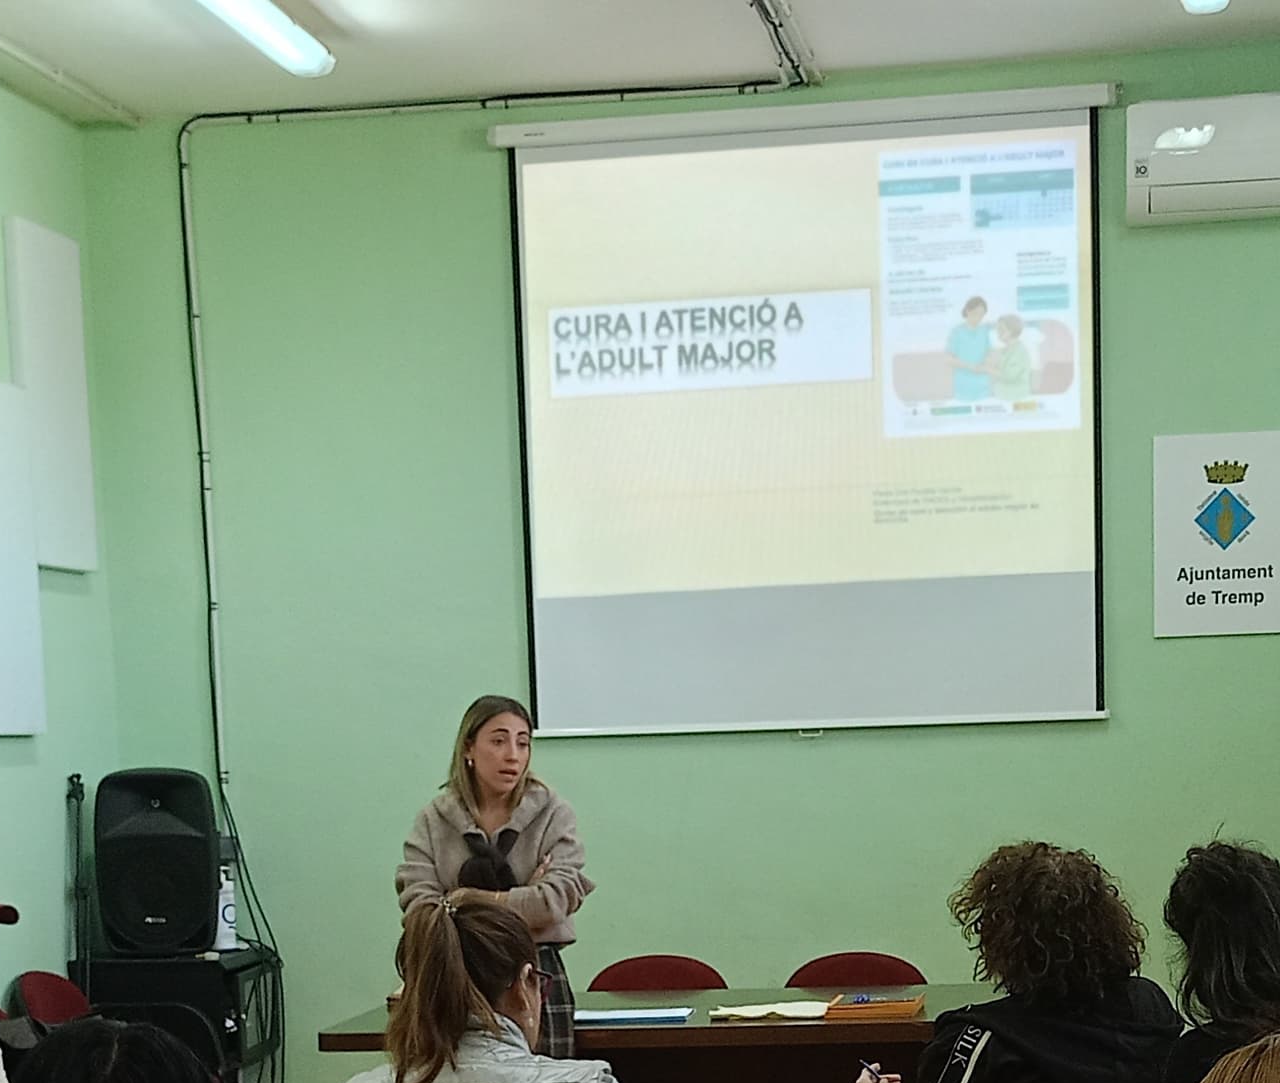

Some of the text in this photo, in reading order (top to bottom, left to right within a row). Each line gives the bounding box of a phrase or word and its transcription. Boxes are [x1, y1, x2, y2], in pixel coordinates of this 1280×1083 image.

[554, 298, 804, 340] CURA I ATENCIÓ A
[555, 338, 776, 376] L'ADULT MAJOR
[1176, 564, 1274, 585] Ajuntament
[1186, 590, 1265, 607] de Tremp
[951, 1025, 982, 1068] SILK
